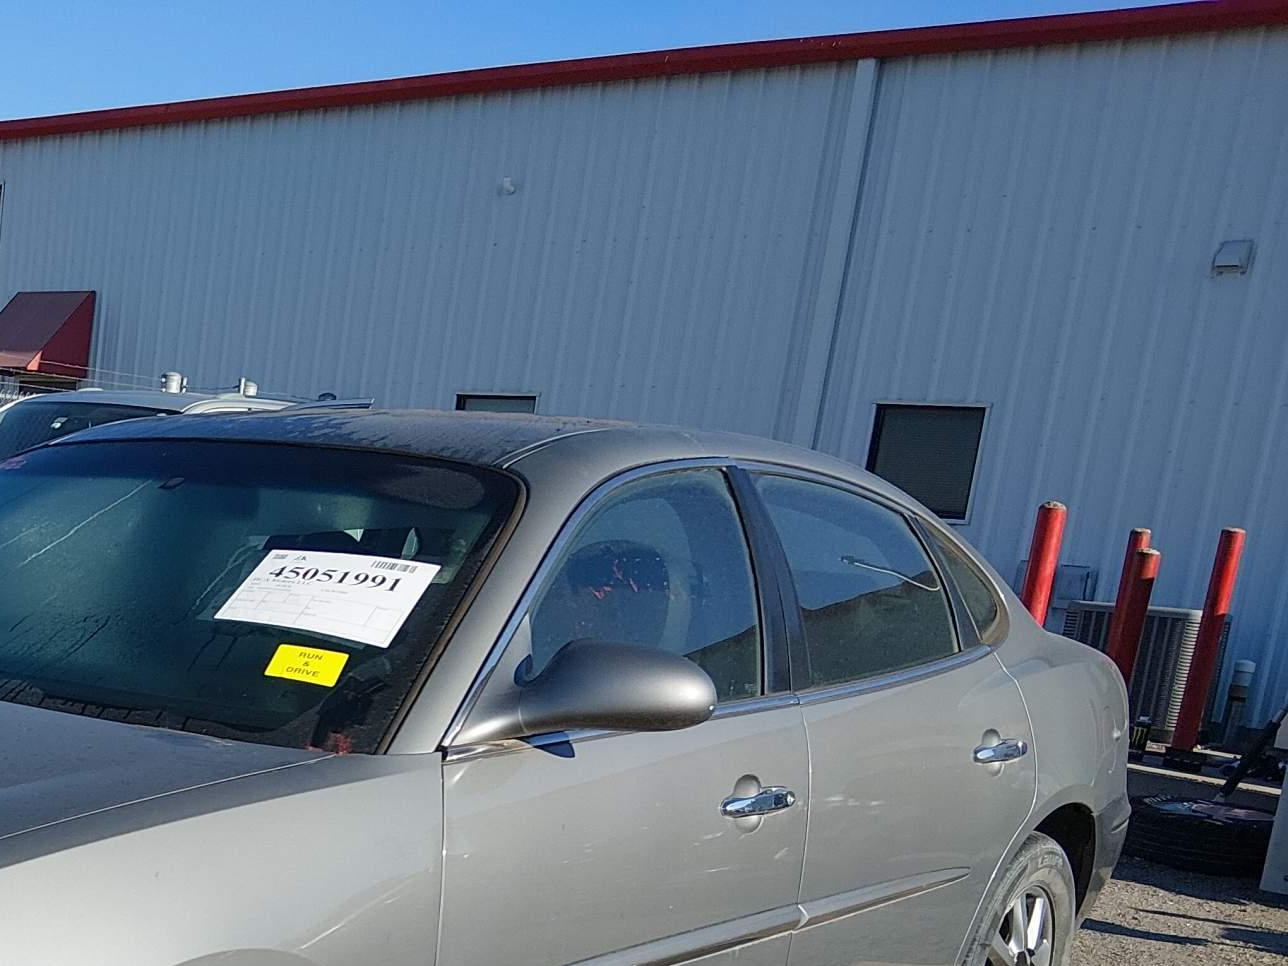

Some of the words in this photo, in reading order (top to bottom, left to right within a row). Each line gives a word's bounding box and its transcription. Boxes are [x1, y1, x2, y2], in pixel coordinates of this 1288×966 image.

[269, 565, 402, 592] 45051991
[298, 652, 324, 661] RUN
[286, 666, 321, 677] DRIVE
